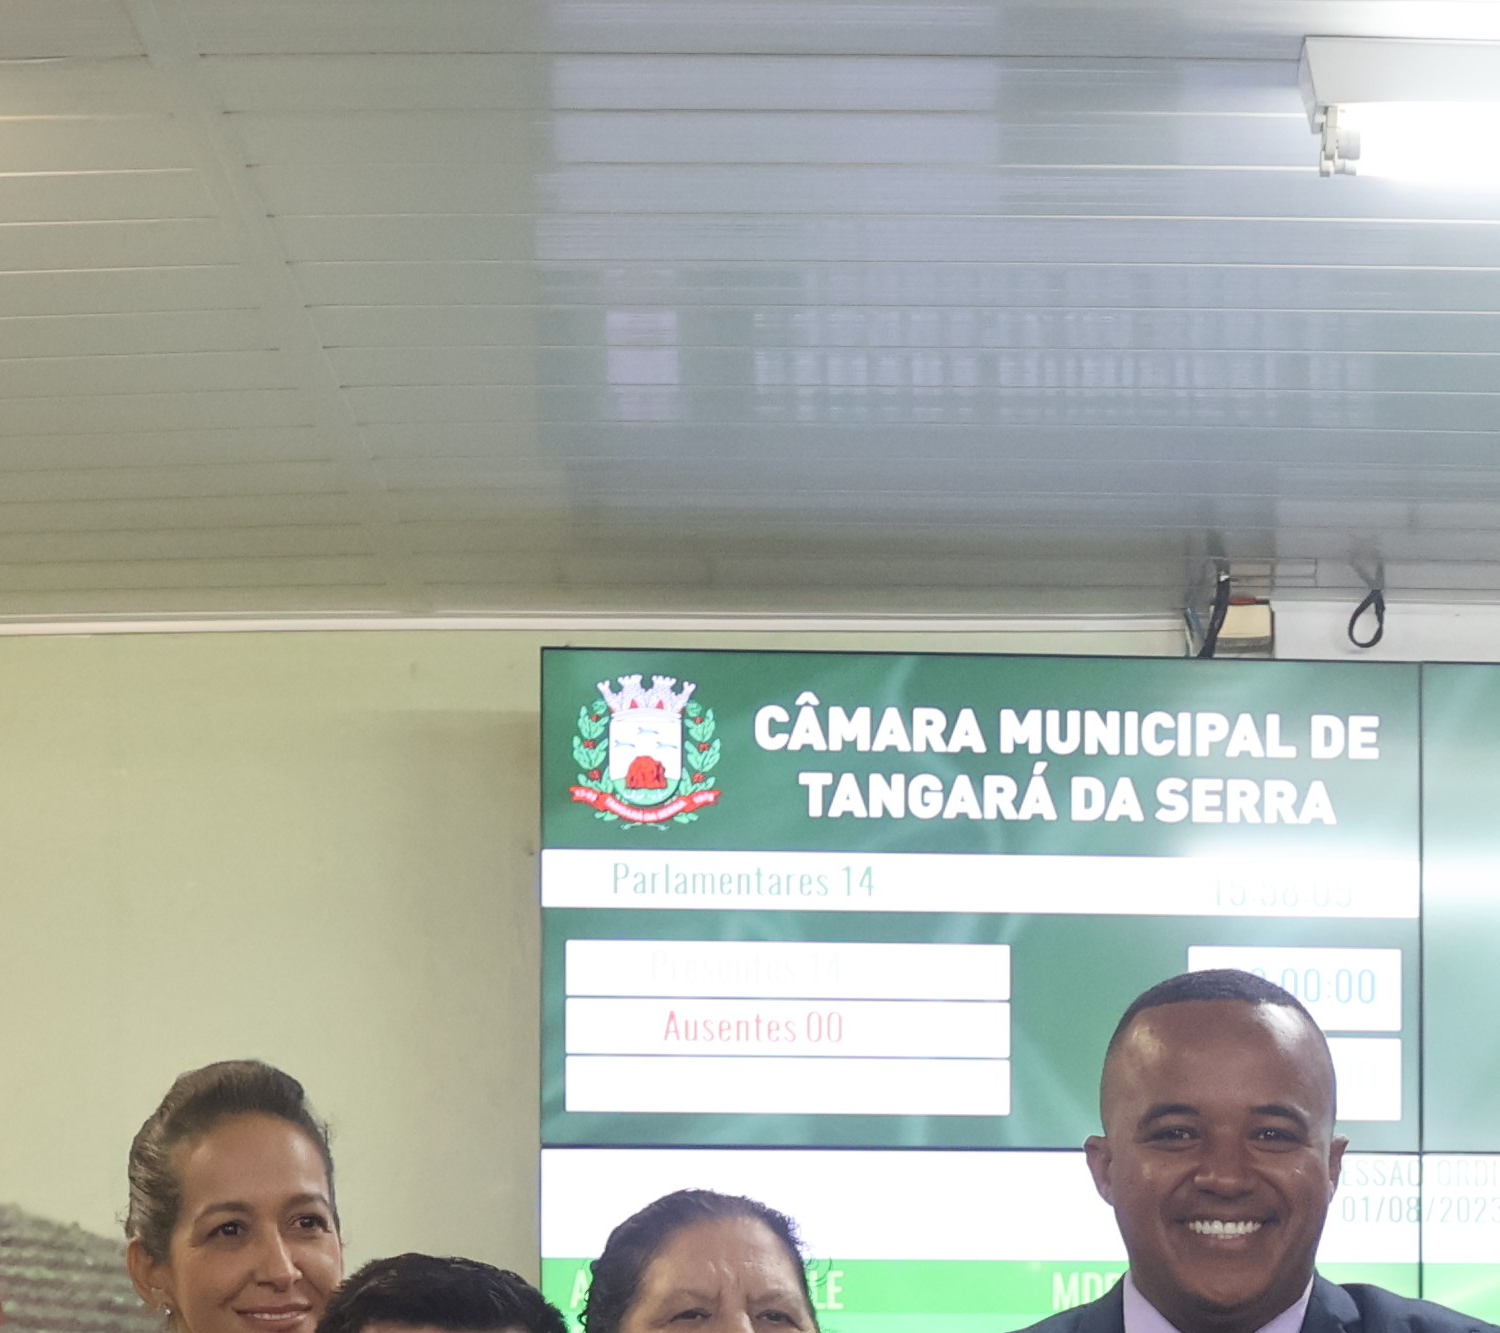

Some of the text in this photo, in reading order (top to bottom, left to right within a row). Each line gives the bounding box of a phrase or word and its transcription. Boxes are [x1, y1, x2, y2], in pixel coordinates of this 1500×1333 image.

[755, 692, 1381, 761] CÂMARA MUNICIPAL DE
[799, 761, 1337, 825] TANGARÁ DA SERRA
[612, 862, 875, 897] Parlamentares 14
[663, 1009, 843, 1043] Ausentes 00
